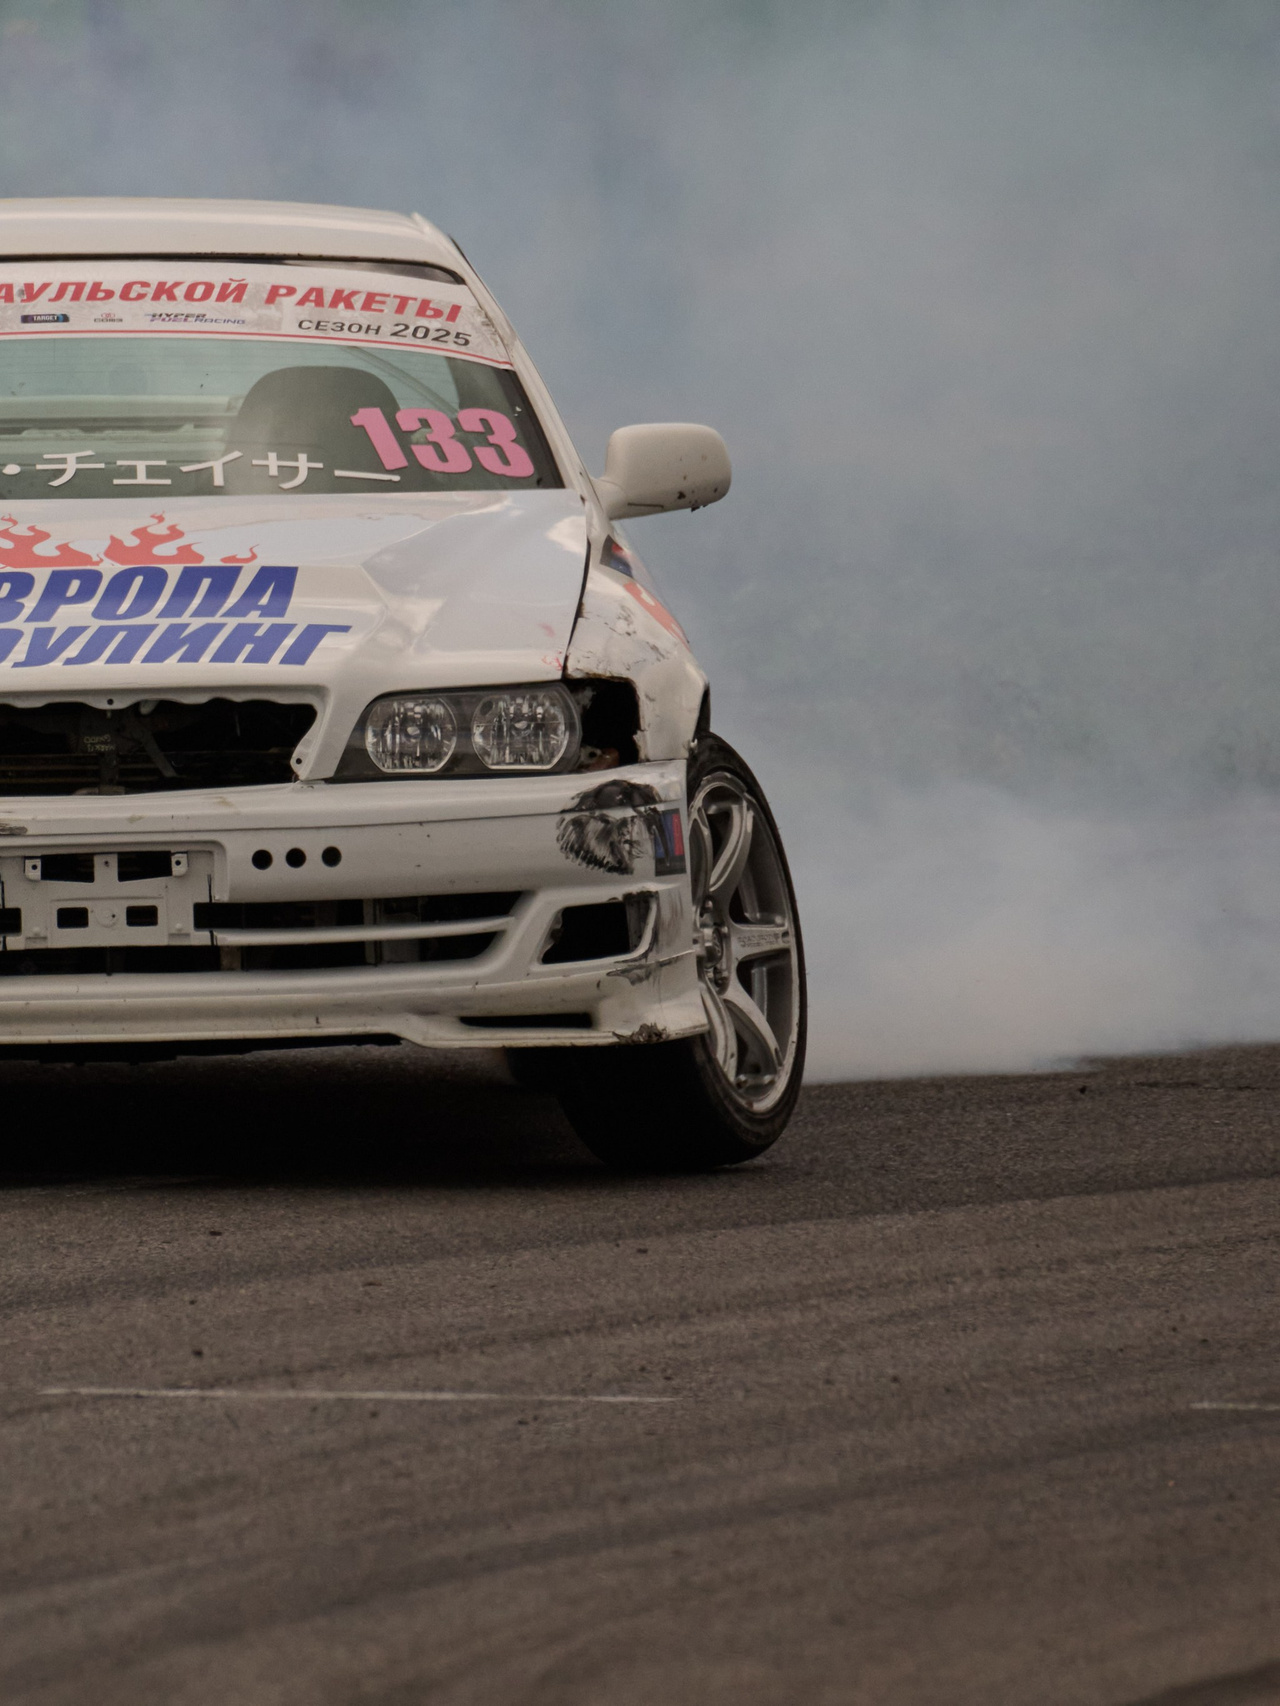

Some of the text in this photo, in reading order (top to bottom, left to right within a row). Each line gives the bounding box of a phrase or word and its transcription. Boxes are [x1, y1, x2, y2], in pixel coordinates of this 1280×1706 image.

[33, 314, 58, 322] TARGET
[264, 284, 463, 325] РАКЕТЫ
[296, 318, 473, 348] СЕЗОН 2025
[349, 406, 535, 479] 133
